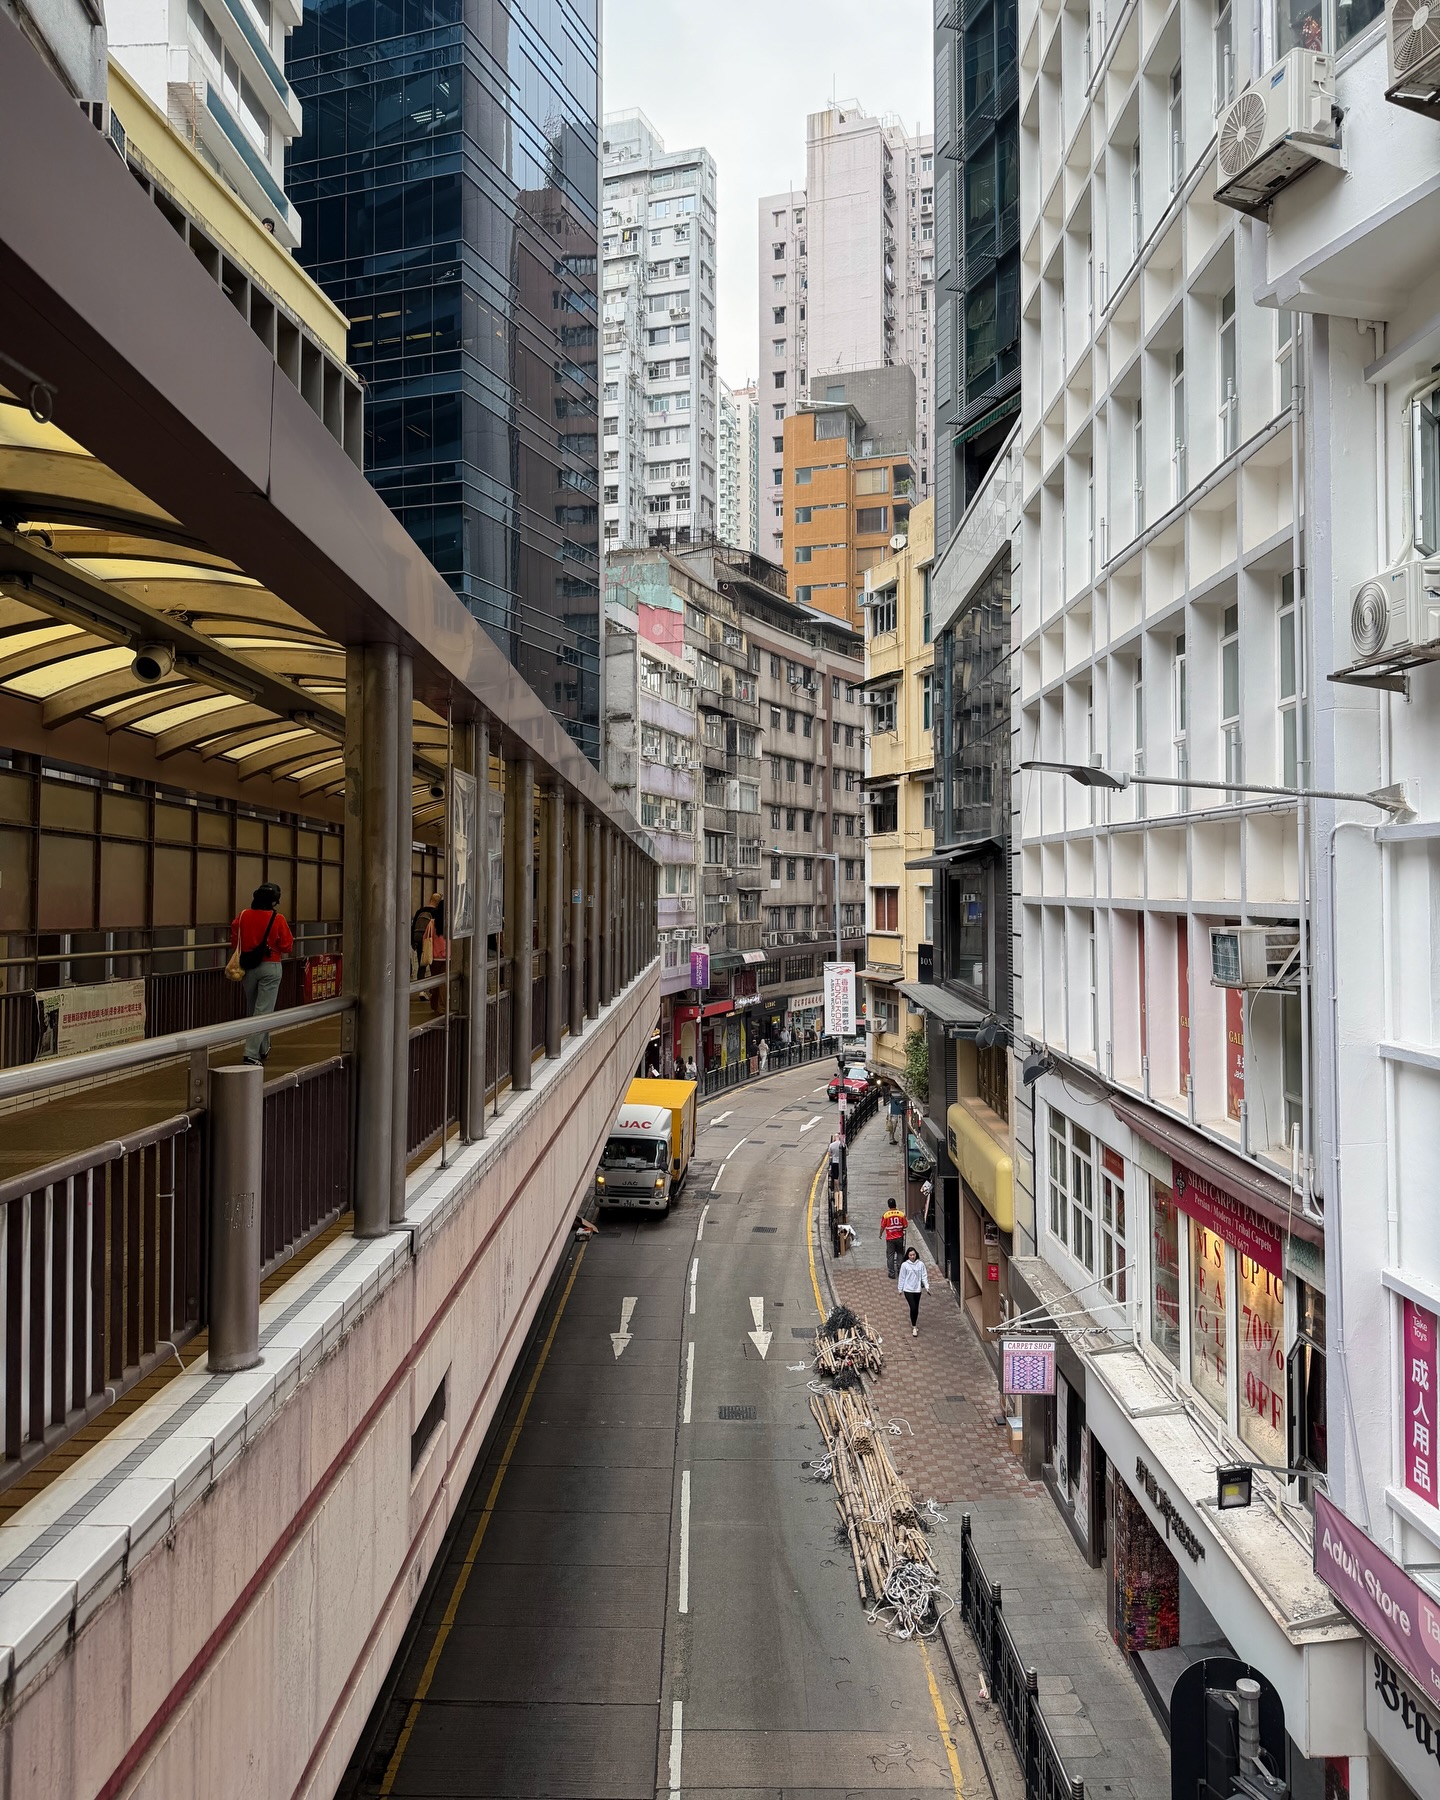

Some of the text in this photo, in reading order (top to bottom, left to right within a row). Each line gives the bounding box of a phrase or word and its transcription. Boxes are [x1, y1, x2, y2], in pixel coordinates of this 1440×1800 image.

[619, 1120, 652, 1129] JAC
[890, 1216, 900, 1226] 10
[1187, 1170, 1208, 1197] SHAH
[1209, 1184, 1241, 1217] CARPET
[1243, 1204, 1281, 1242] PALACE
[1194, 1193, 1211, 1211] Persian
[1213, 1205, 1232, 1227] Modern
[1234, 1219, 1251, 1239] Tribal
[1251, 1230, 1272, 1253] Carpets
[1213, 1220, 1250, 1254] TEL: 2521 6677
[1195, 1226, 1211, 1374] MEGA
[1212, 1239, 1225, 1388] SALE
[1412, 1315, 1428, 1333] Take
[1007, 1342, 1052, 1350] CARPET SHOP
[1242, 1304, 1285, 1371] 70%
[1412, 1326, 1428, 1342] Toys
[1246, 1370, 1284, 1432] OFF
[1411, 1357, 1431, 1493] 成人用品
[1322, 1527, 1412, 1638] Adult Store
